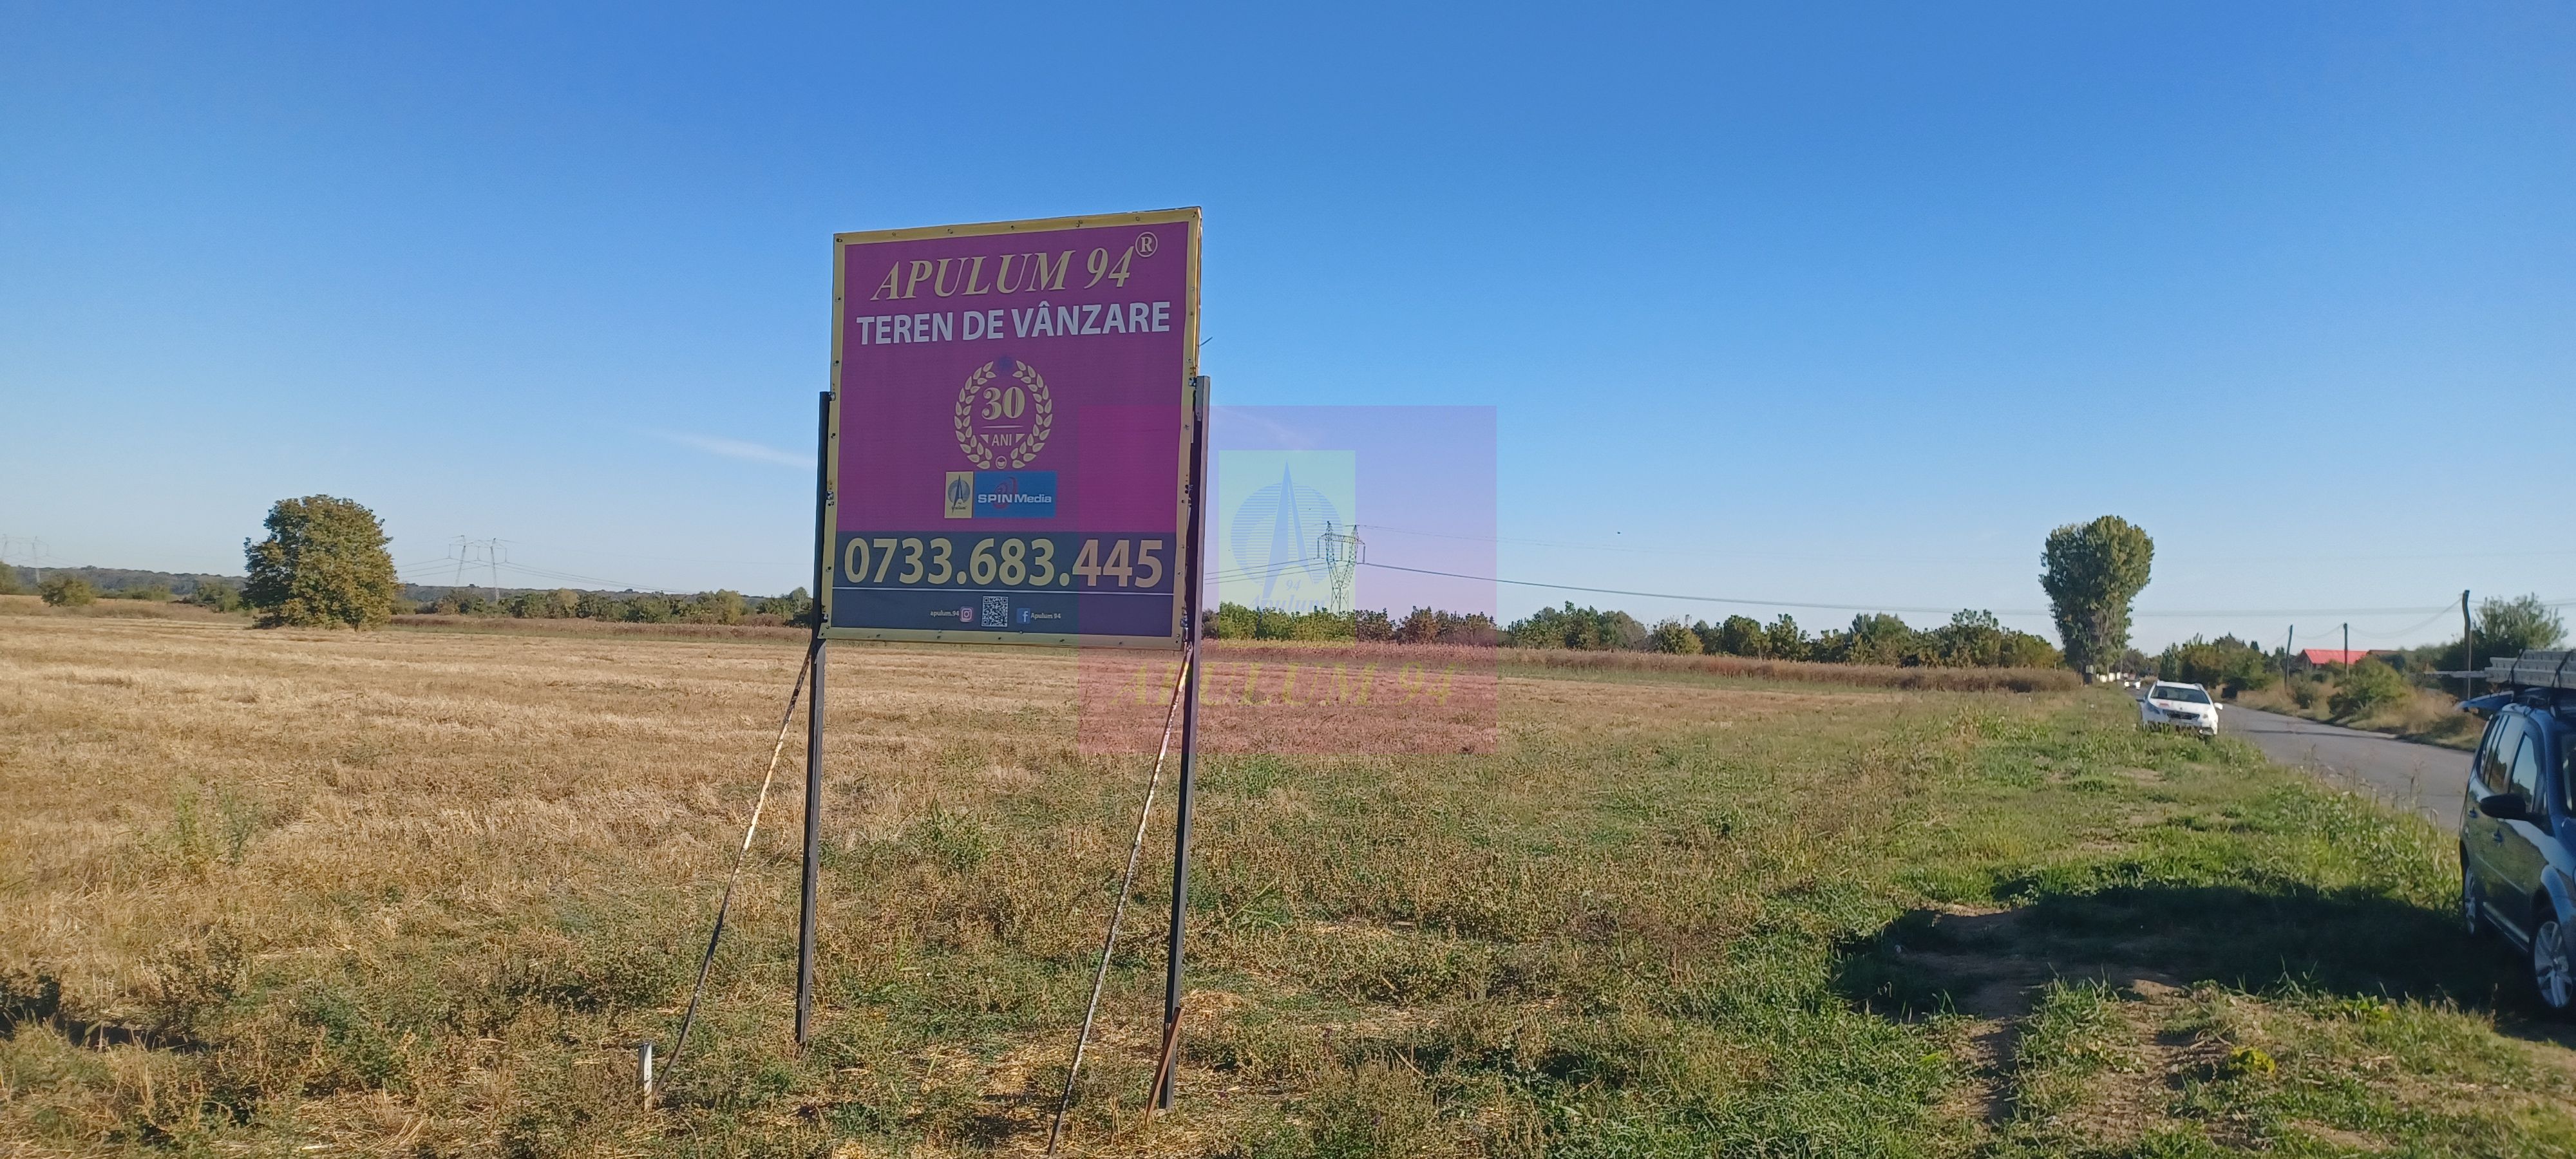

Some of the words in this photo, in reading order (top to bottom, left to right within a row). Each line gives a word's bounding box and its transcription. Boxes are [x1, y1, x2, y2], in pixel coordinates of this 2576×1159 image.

[869, 249, 1076, 301] APULUM
[856, 311, 953, 346] TEREN
[963, 309, 1005, 341] DE
[1011, 300, 1171, 339] VÂNZARE
[981, 386, 1025, 420] 30
[992, 433, 1012, 447] ANI
[978, 494, 1012, 504] SPIN
[1014, 493, 1052, 504] Media
[844, 536, 1163, 589] 0733.683.445
